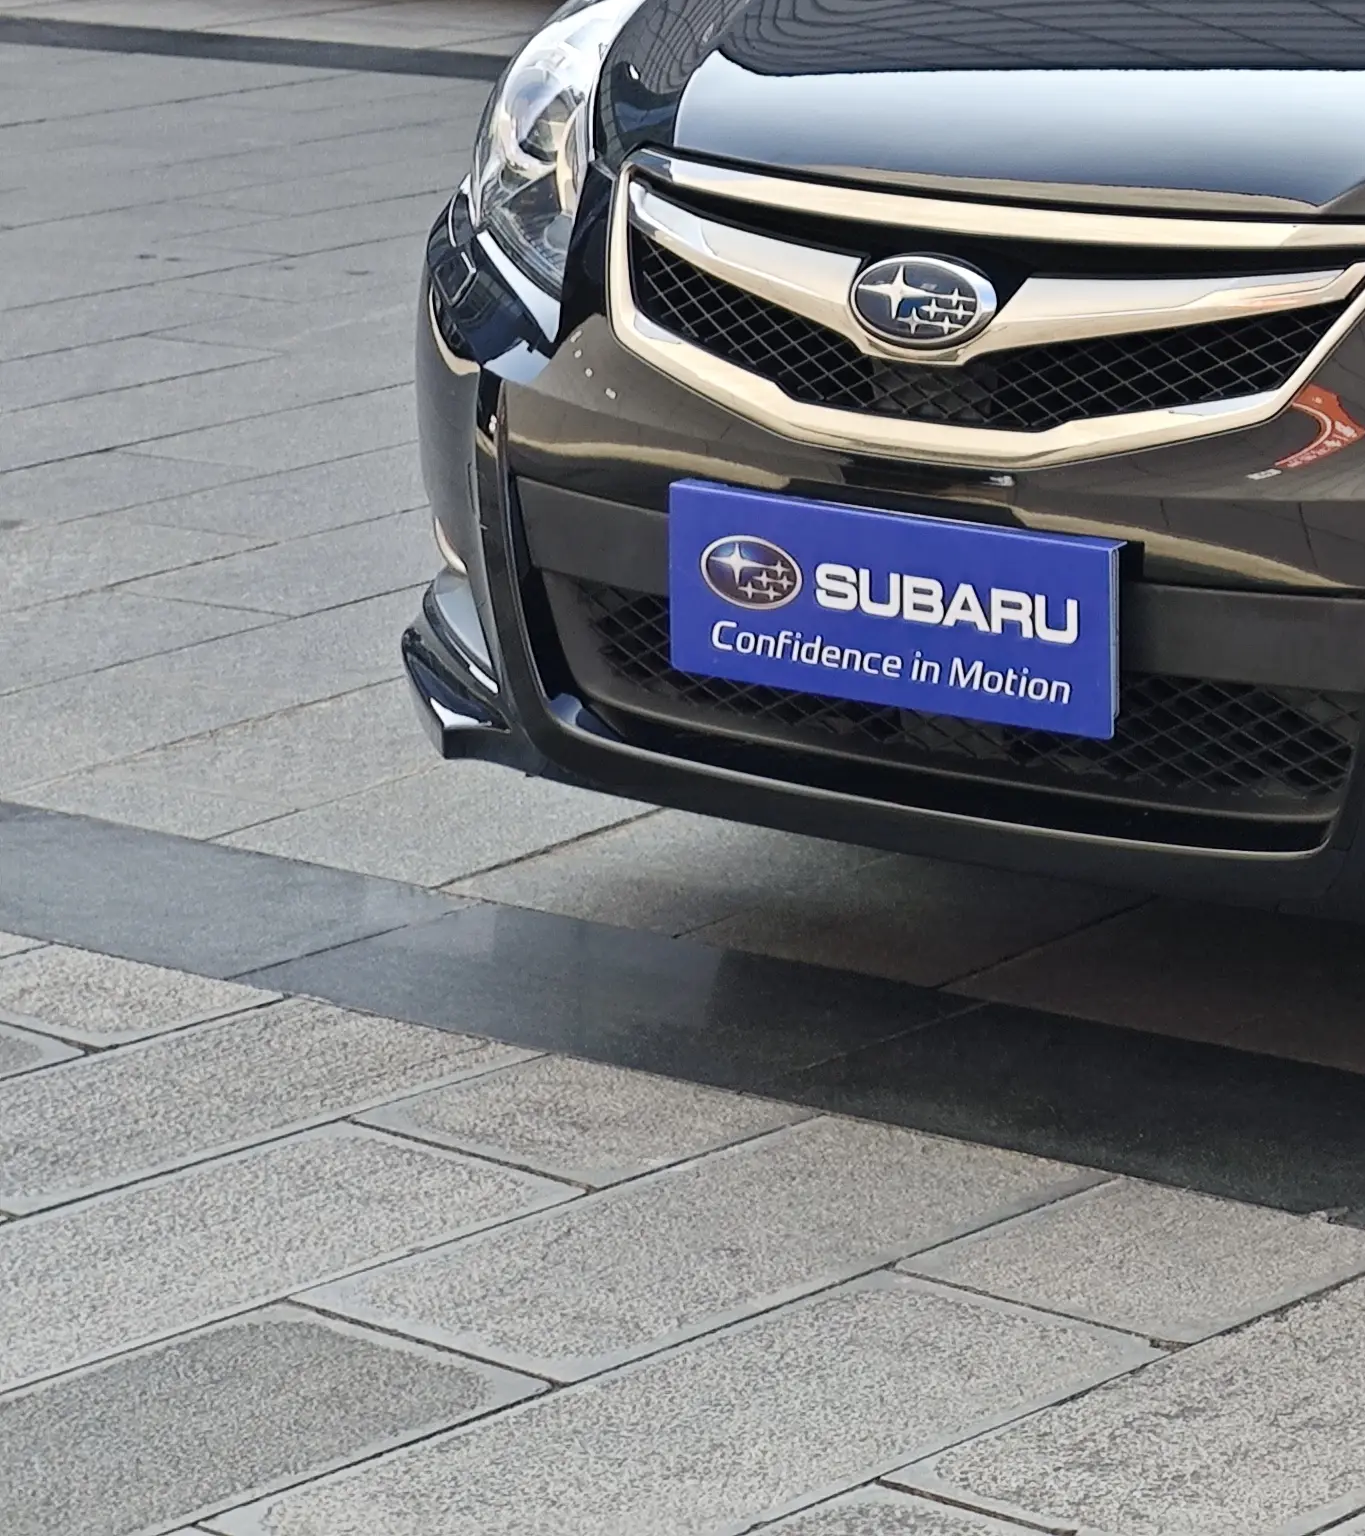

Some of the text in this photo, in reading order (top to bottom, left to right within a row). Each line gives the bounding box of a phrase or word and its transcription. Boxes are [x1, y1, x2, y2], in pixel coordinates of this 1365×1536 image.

[814, 562, 1079, 644] SUBARU
[711, 620, 1071, 704] Confidence in Motion
